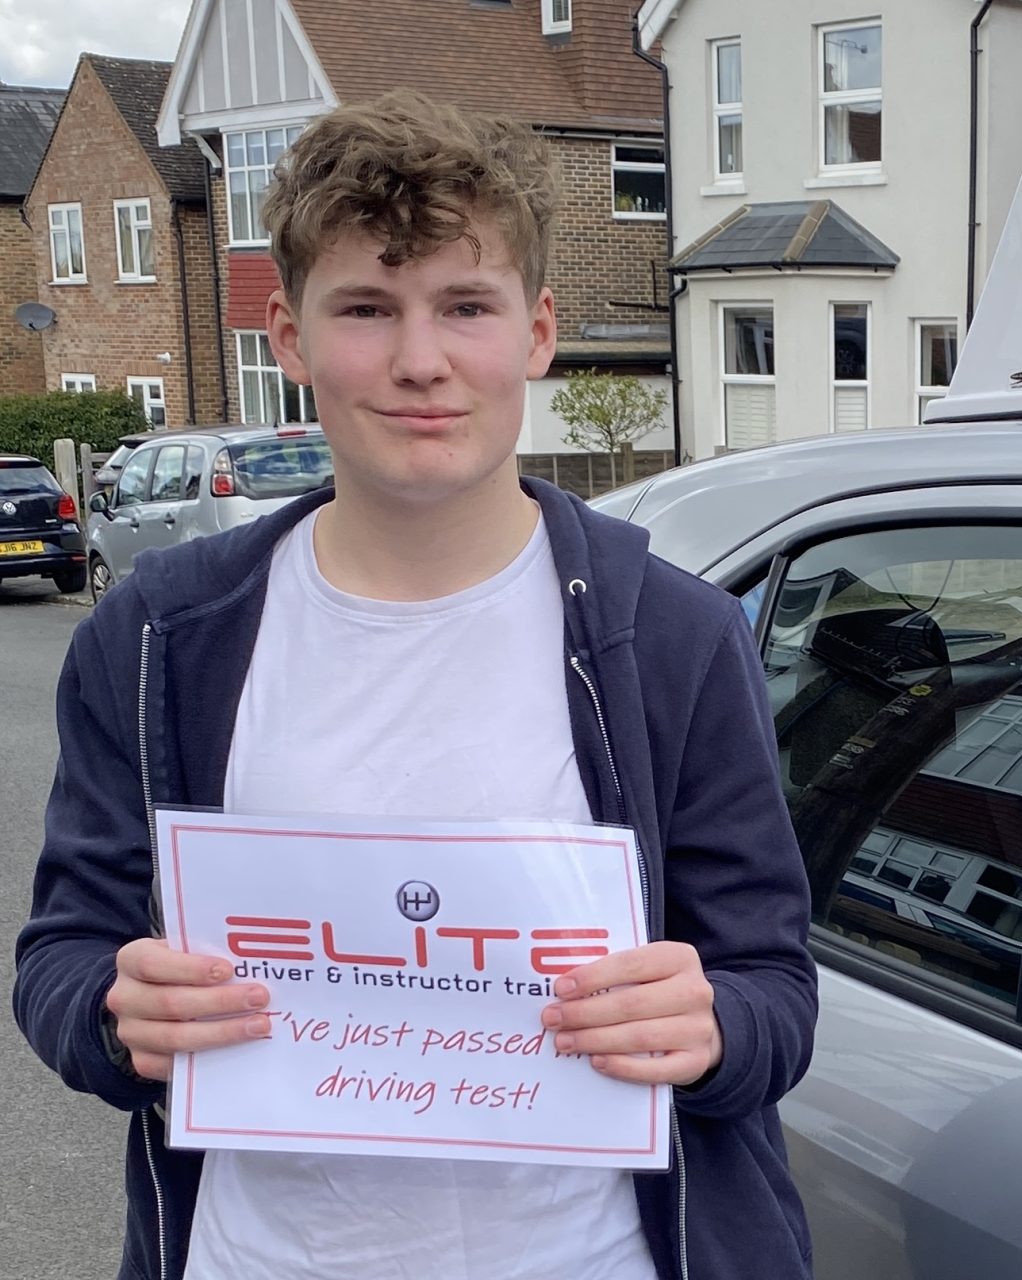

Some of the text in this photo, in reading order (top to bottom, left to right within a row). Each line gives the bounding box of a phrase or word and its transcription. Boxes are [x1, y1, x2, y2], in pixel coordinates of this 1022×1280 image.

[225, 915, 609, 974] ELITE
[234, 960, 314, 982] driver
[326, 966, 342, 984] &
[353, 966, 492, 993] instructor
[256, 1011, 547, 1057] 've just passed
[315, 1065, 542, 1115] driving test!
